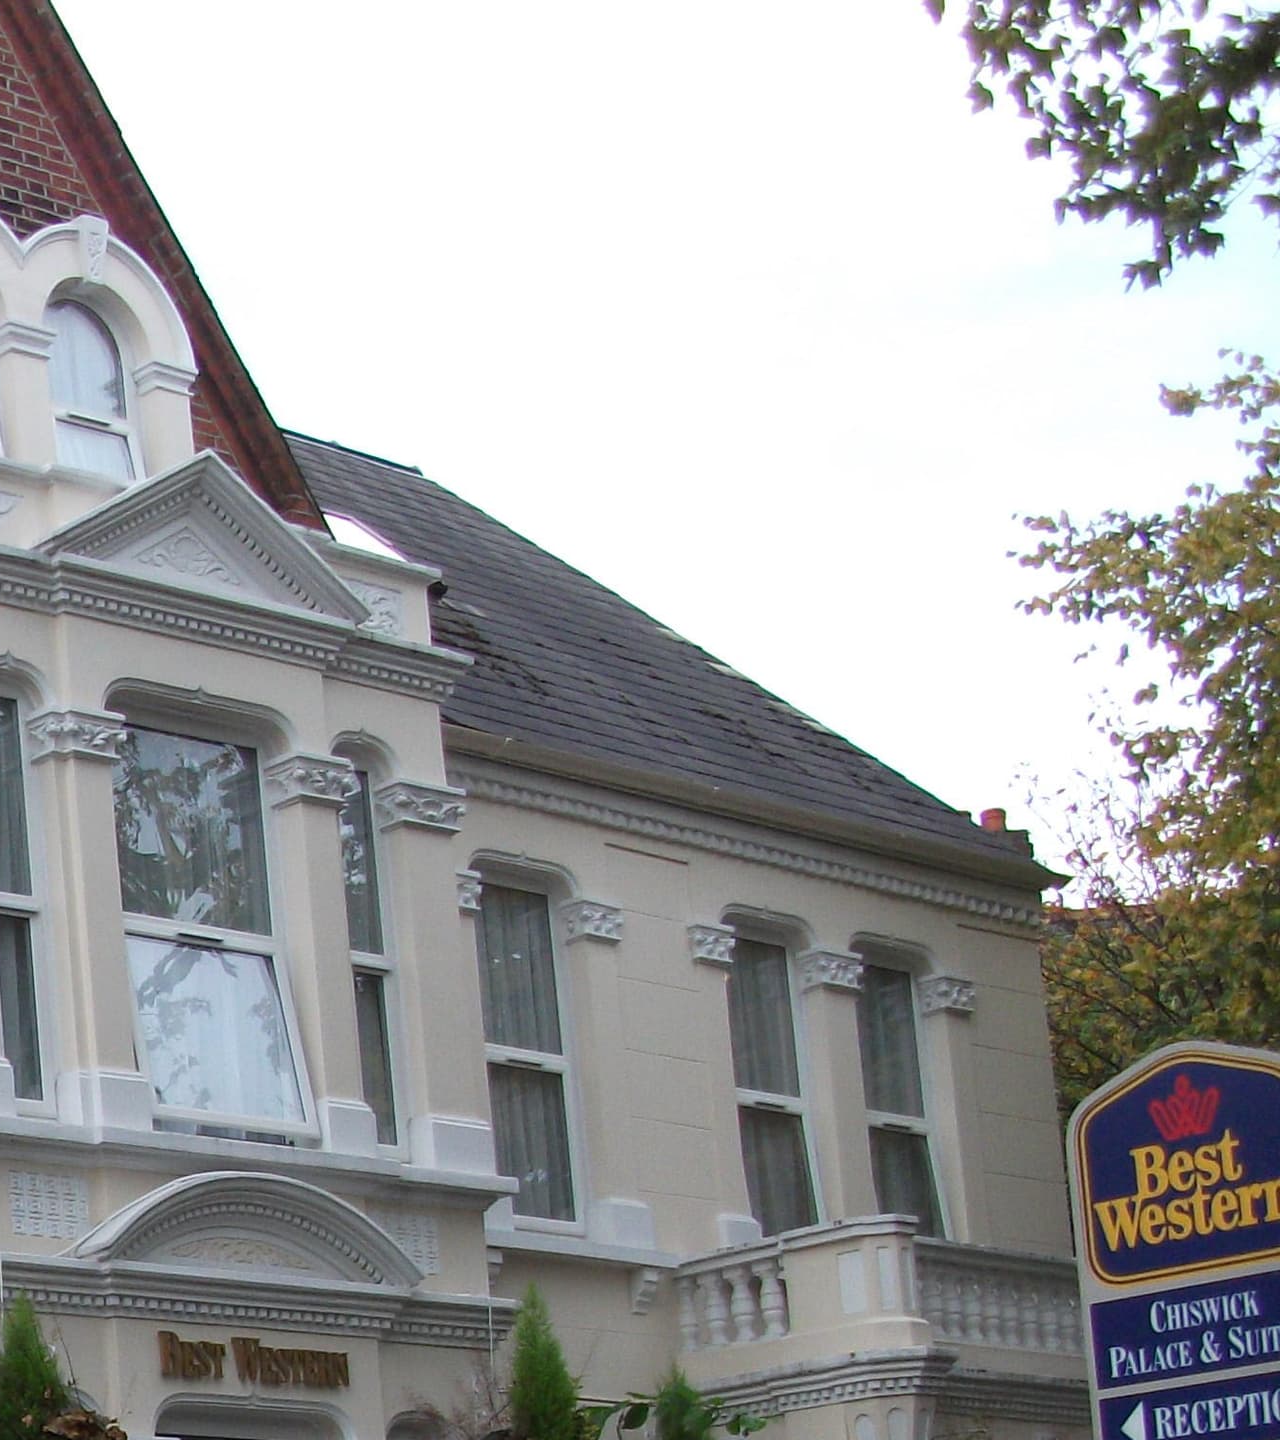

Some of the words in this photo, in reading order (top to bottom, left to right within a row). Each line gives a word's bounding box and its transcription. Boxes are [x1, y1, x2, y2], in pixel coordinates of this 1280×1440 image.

[1129, 1128, 1243, 1200] Best
[1149, 1290, 1259, 1334] CHISWICK
[157, 1330, 226, 1379] BEST
[230, 1336, 350, 1388] WESTERN
[1109, 1340, 1193, 1379] PALACE
[1199, 1330, 1223, 1364] &
